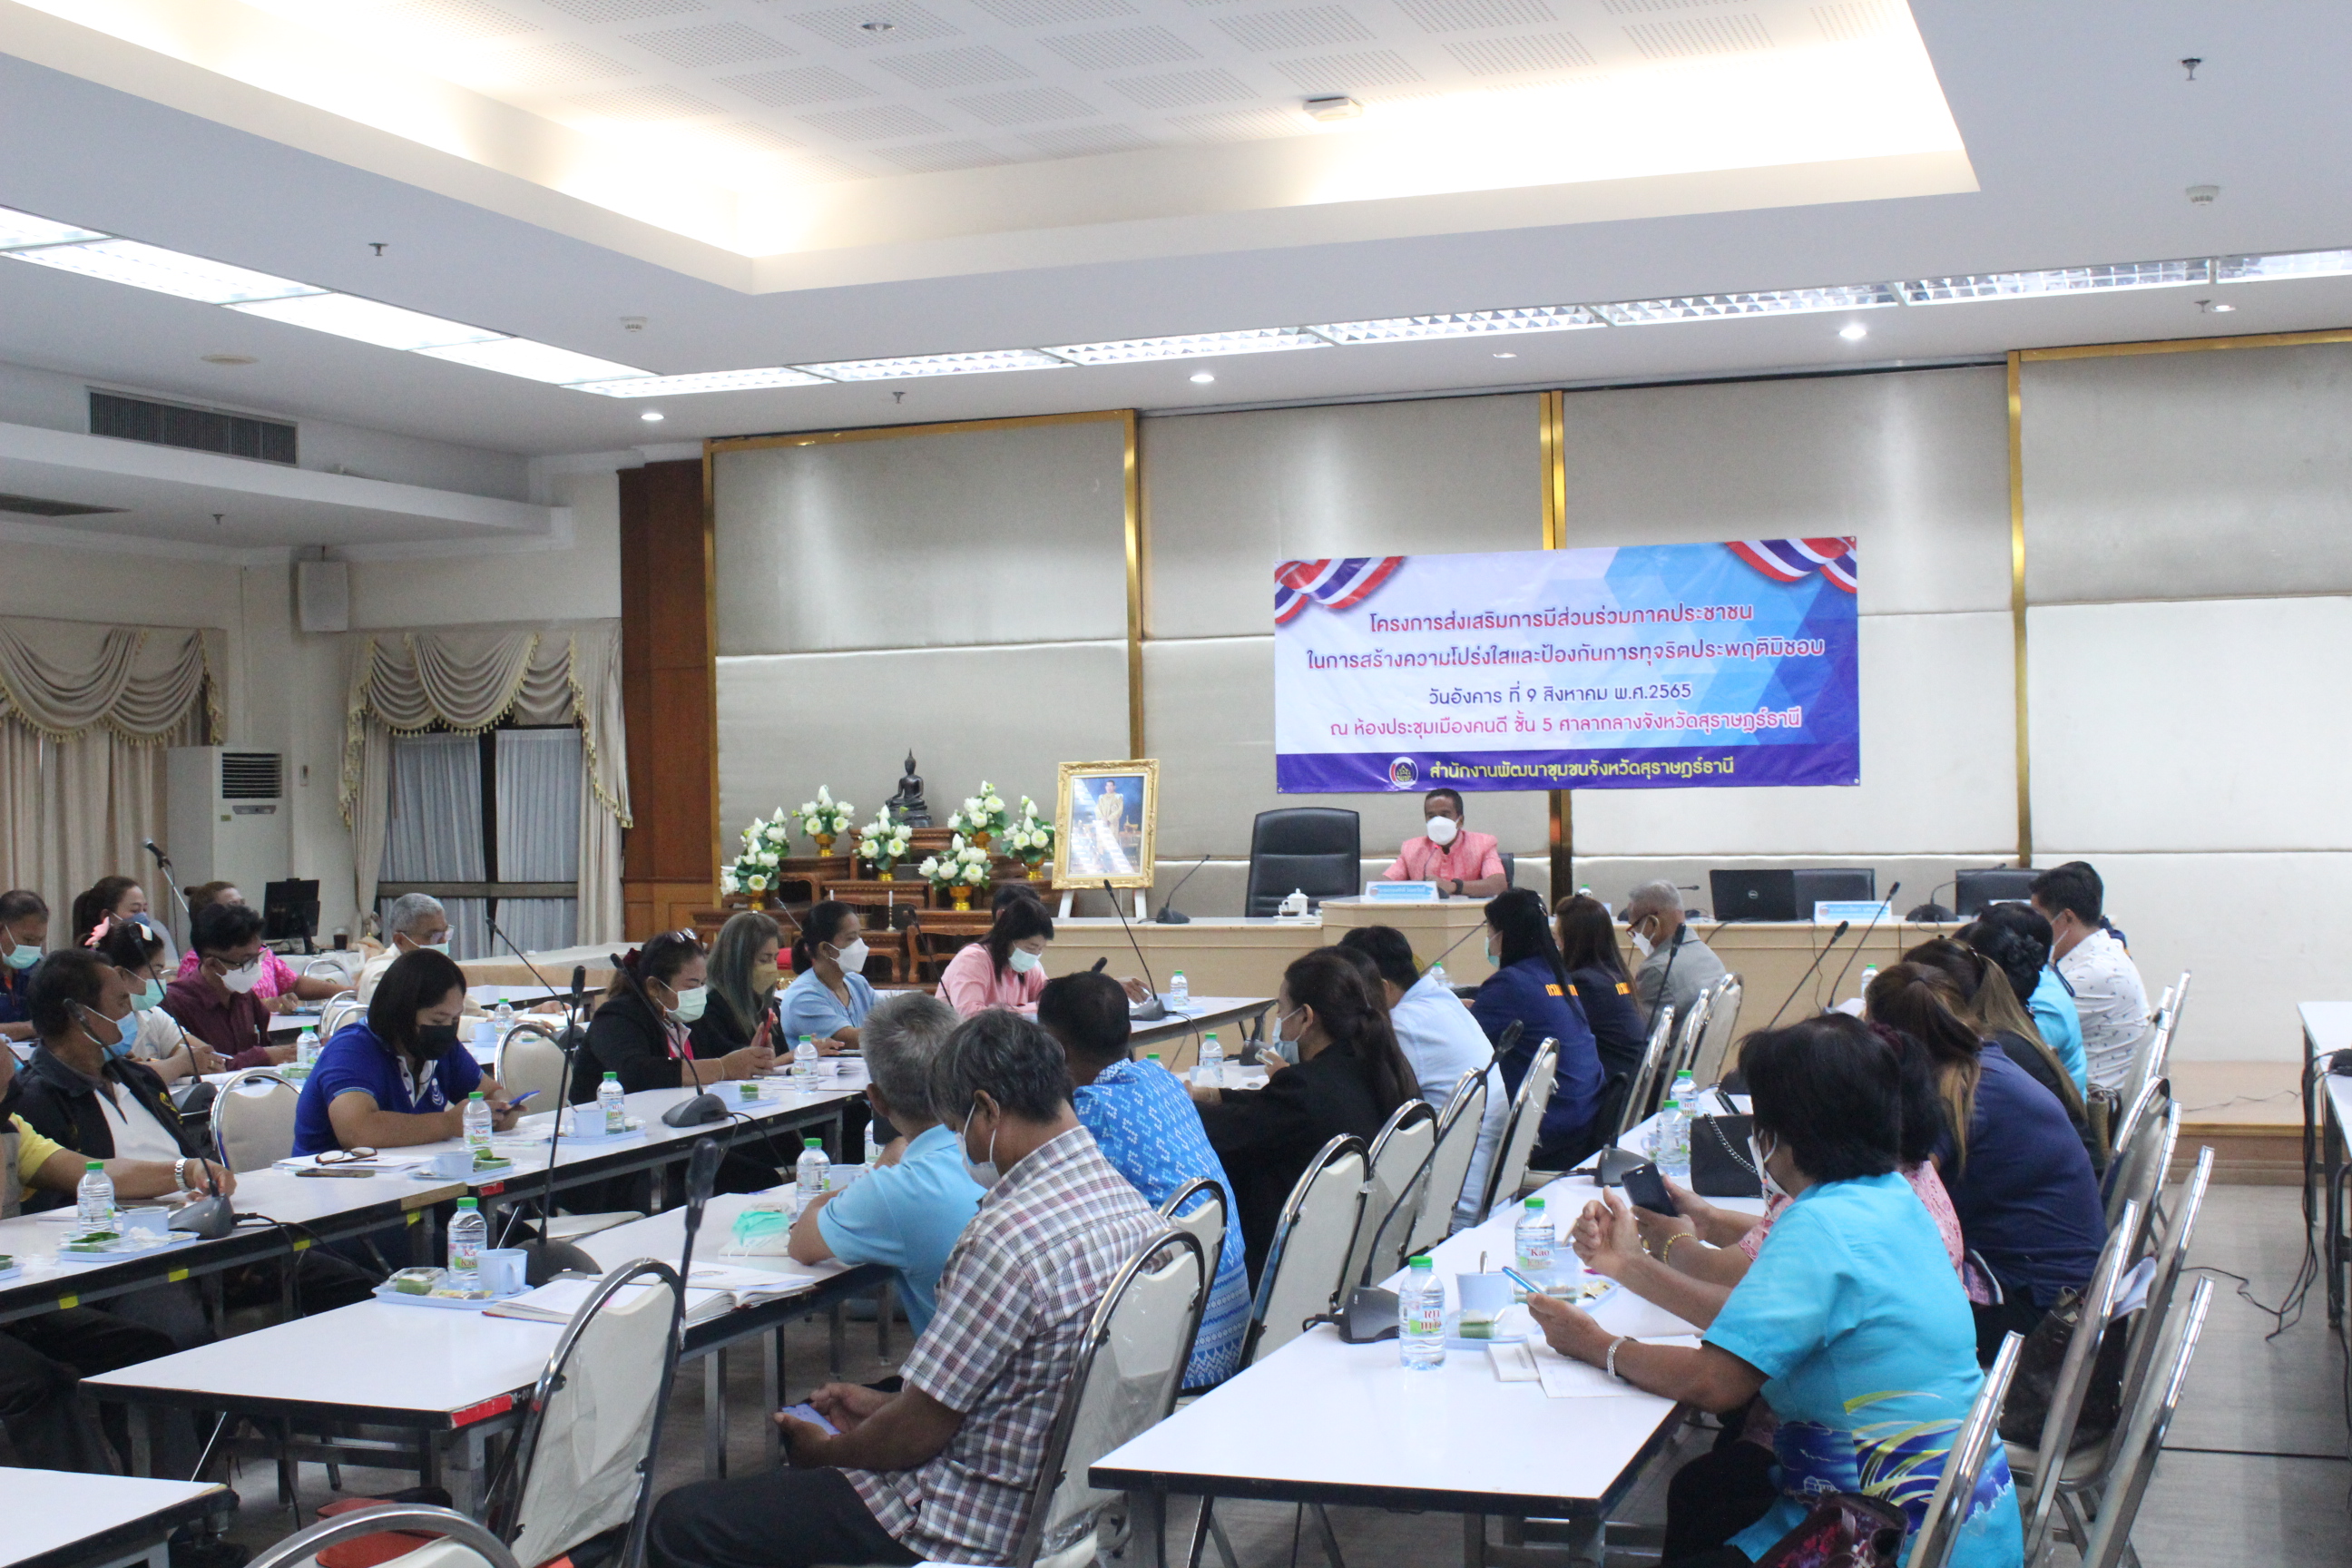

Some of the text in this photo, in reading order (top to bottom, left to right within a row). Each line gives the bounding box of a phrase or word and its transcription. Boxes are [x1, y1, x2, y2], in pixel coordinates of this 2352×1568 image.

[1370, 603, 1753, 632] โครงการส่งเสริมการมีส่วนร่วมภาคประชาชน
[1307, 637, 1825, 669] ในการสร้างความโปร่งใสและป้องกันการทุจริตประพฤติมิชอบ
[1429, 681, 1691, 704] วันอังคาร ที่ 9 สิงหาคม พ.ศ.2565
[1330, 706, 1802, 740] ณ ห้องประชุมเมืองคนดี ชั้น 5 ศาลากลางจังหวัดสุราษฎร์ธานี
[1429, 756, 1735, 782] สำนักงานพัฒนาชุมชนจังหวัดสุราษฎร์ธานี
